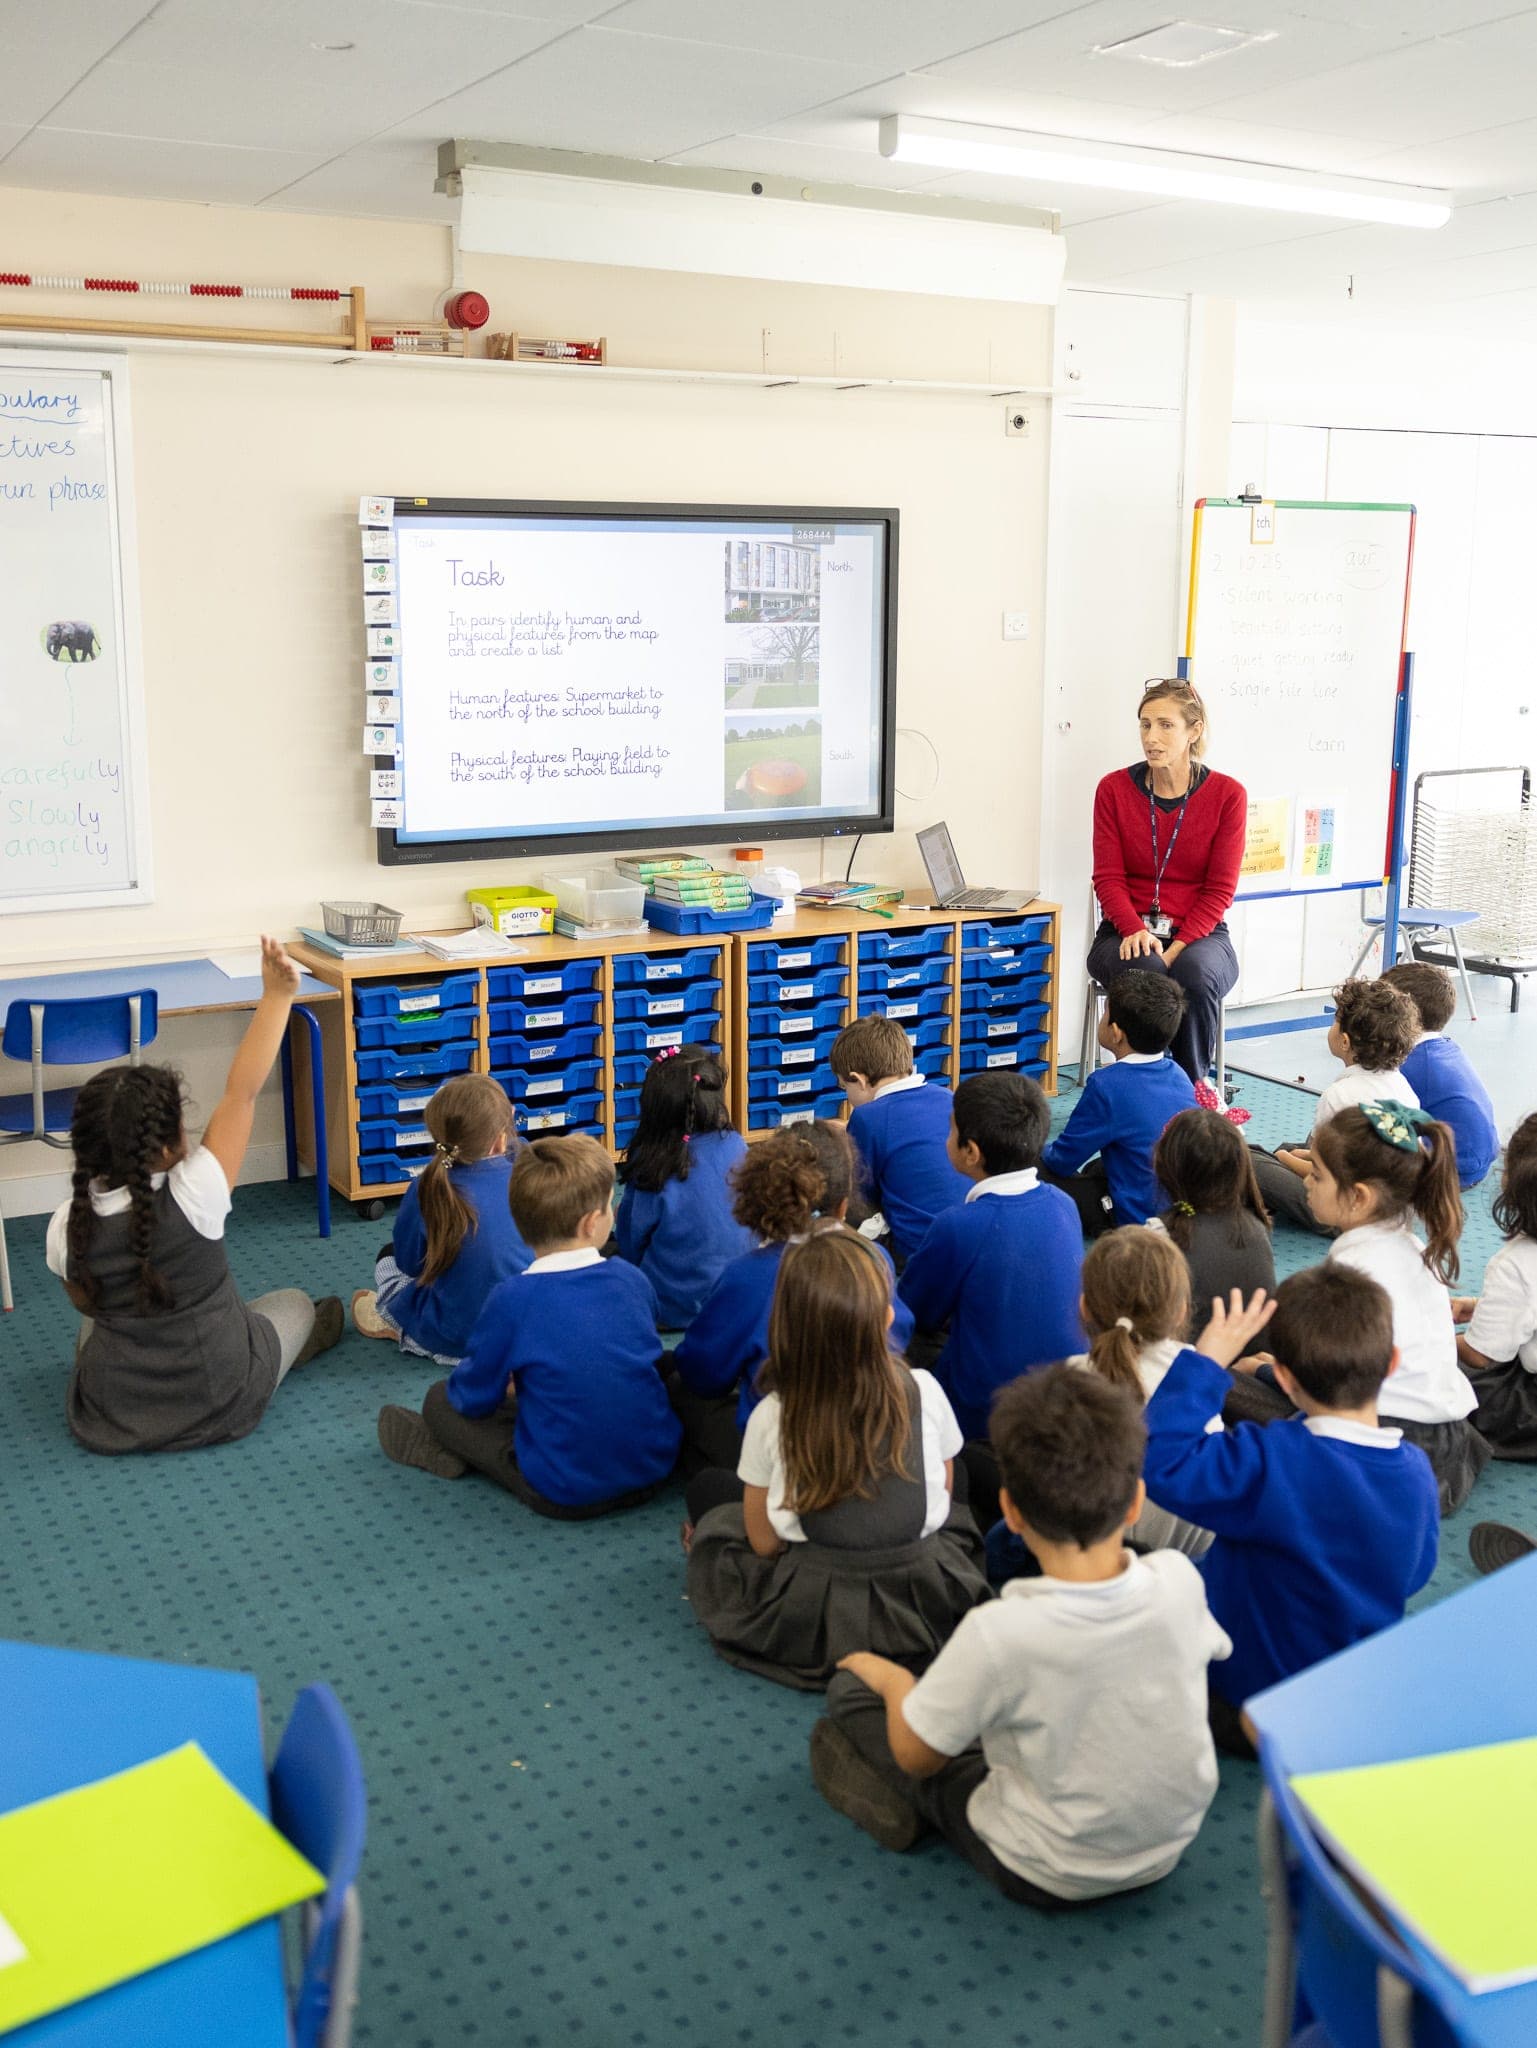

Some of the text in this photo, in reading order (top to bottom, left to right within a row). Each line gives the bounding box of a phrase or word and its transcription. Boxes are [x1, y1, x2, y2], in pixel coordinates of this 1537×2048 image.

[49, 475, 106, 512] phrase
[1256, 516, 1271, 529] tch
[797, 530, 831, 540] 268444
[445, 559, 505, 586] Task
[827, 560, 853, 573] North
[448, 609, 642, 631] In pairs identify human and
[448, 626, 660, 648] physical features from the map
[448, 642, 476, 656] and
[480, 642, 524, 656] create
[528, 647, 538, 656] a
[448, 689, 501, 704] Human
[566, 685, 646, 706] Supermarket
[650, 685, 665, 700] to
[448, 699, 662, 724] the north of the school building
[450, 751, 508, 771] Physical
[572, 747, 621, 767] Playing
[625, 744, 654, 763] field
[656, 744, 671, 759] to
[828, 749, 856, 761] South
[0, 758, 120, 793] carefully
[449, 759, 663, 784] the south of the school building
[4, 833, 110, 868] angrily
[511, 911, 539, 920] GIOTTO
